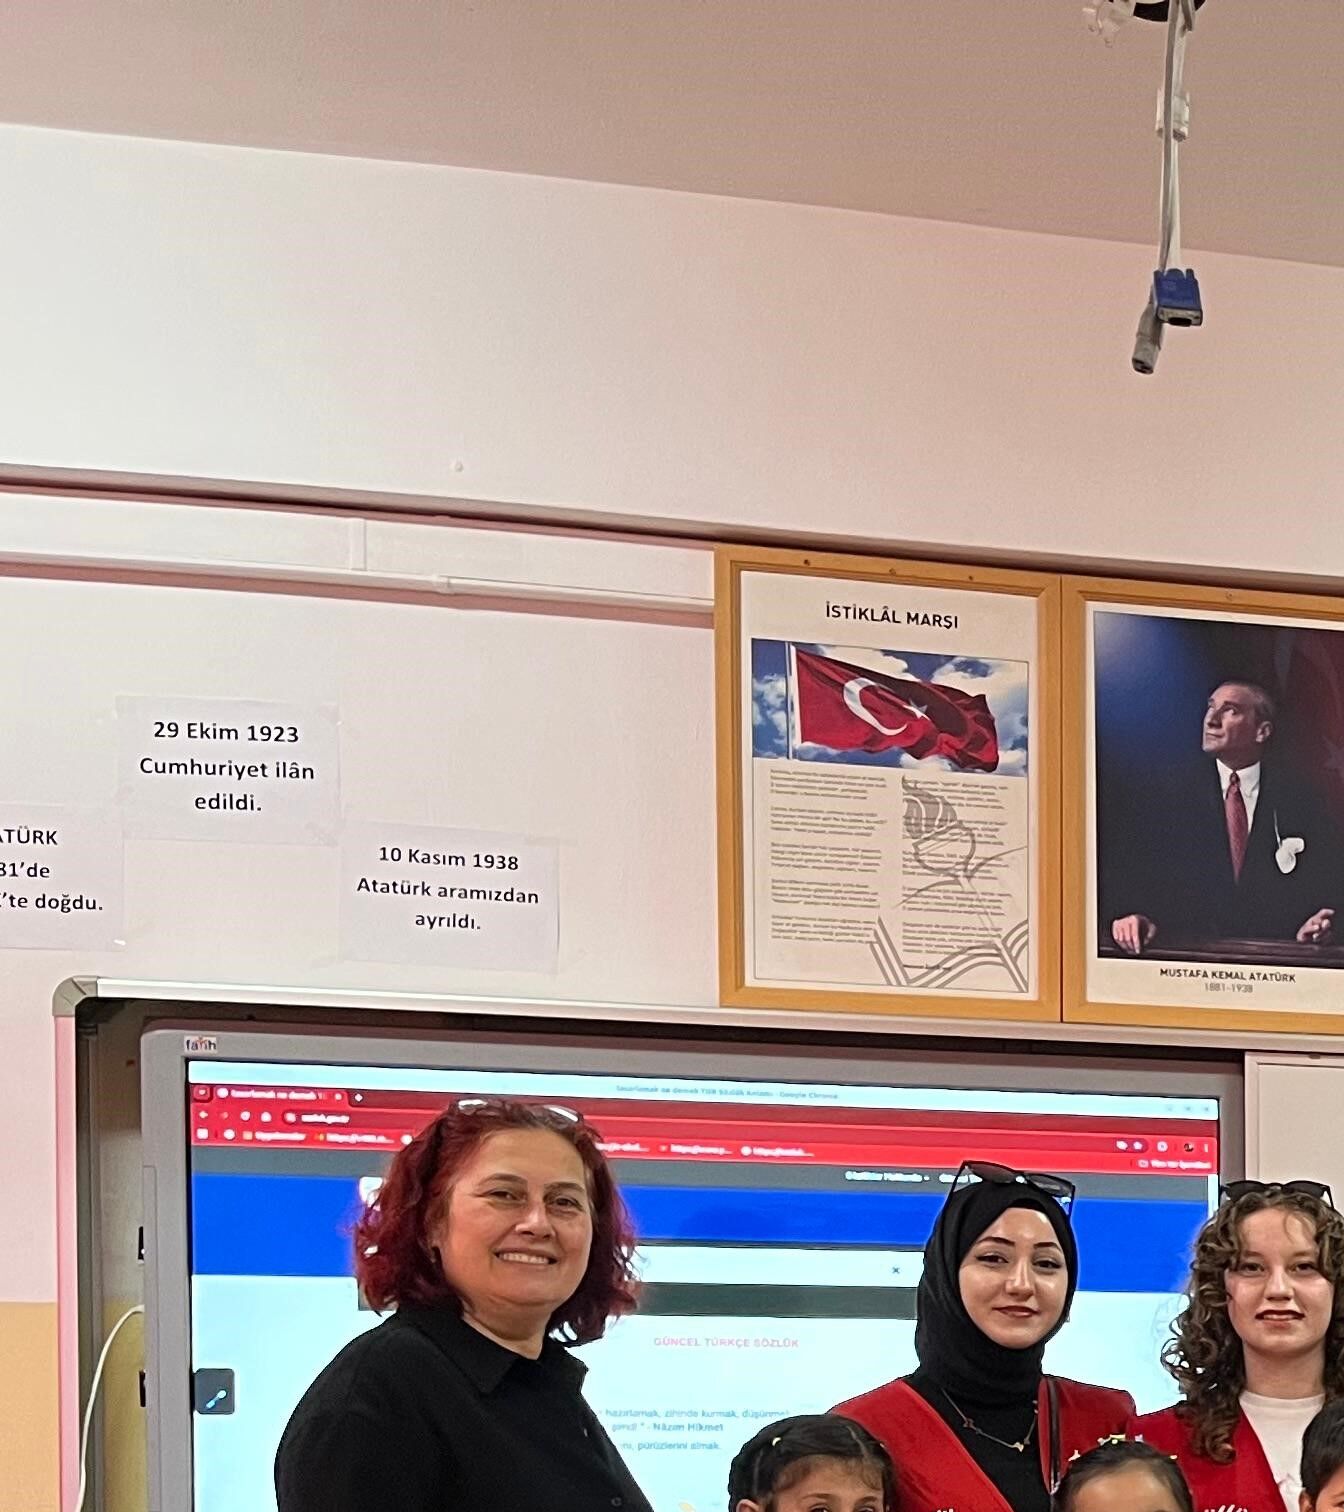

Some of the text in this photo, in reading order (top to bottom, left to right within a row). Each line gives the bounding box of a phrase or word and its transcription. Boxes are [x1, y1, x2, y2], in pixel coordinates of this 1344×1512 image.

[826, 601, 959, 630] İSTİKLÂL MARŞI
[153, 721, 299, 743] 29 Ekim 1923
[139, 757, 315, 781] Cumhuriyet ilân
[194, 793, 262, 812] edildi.
[379, 847, 519, 871] 10 Kasım 1938
[357, 877, 539, 906] Atatürk aramızdan
[35, 893, 103, 914] doğdu.
[414, 912, 482, 933] ayrıldı.
[1160, 967, 1296, 983] MUSTAFA KEMAL ATATÜRK
[653, 1336, 800, 1349] GÜNCEL TÜRKÇE SÖZLÜK
